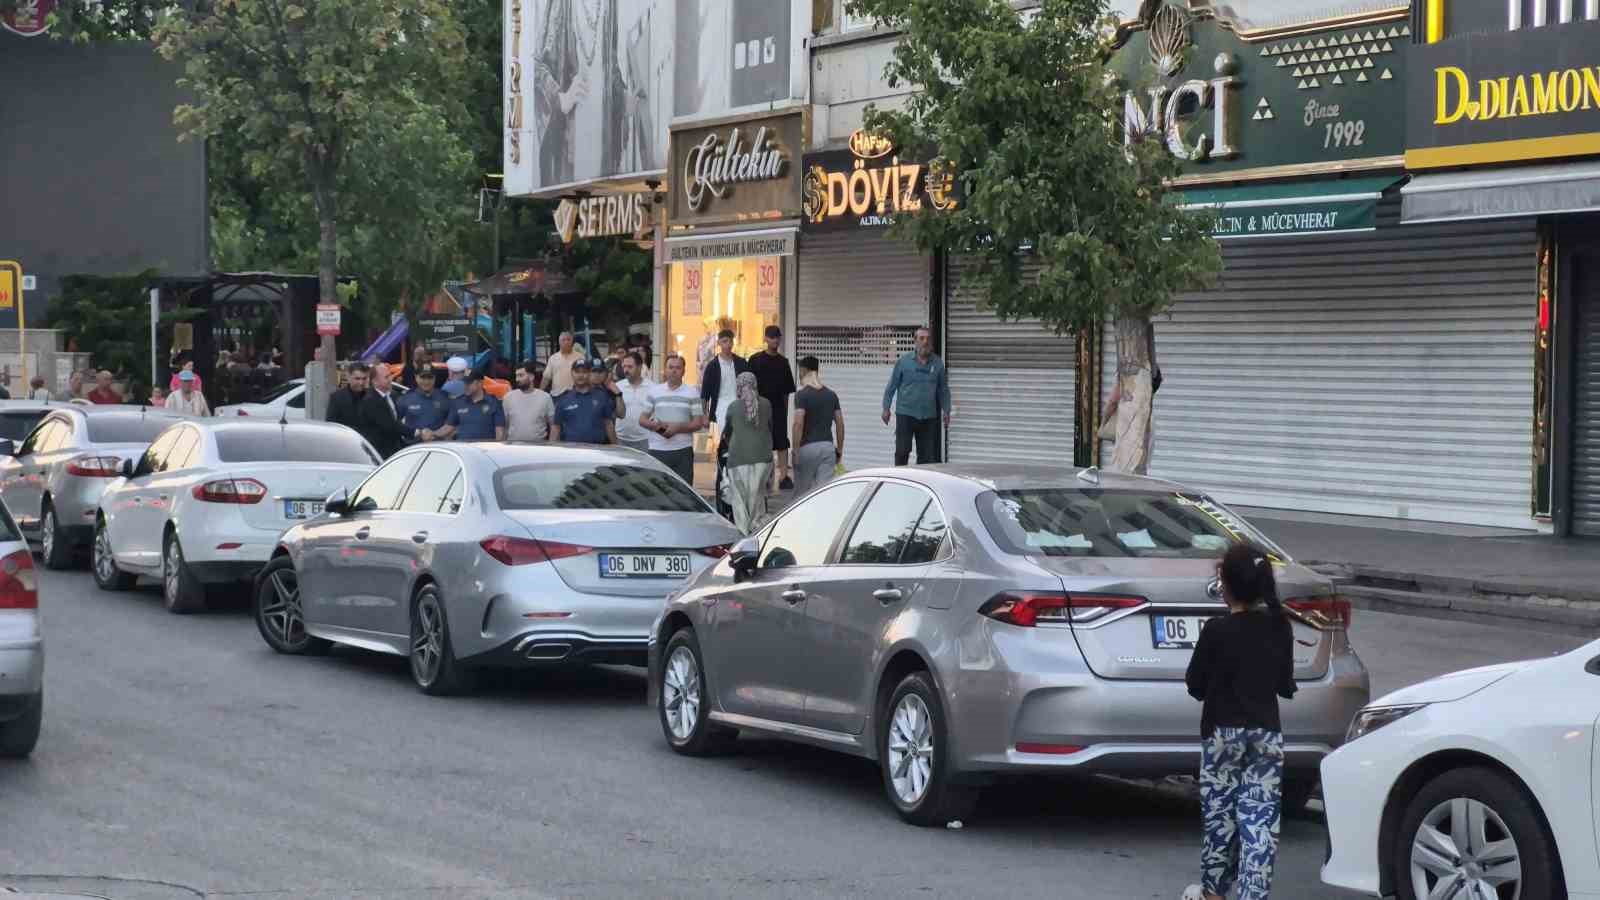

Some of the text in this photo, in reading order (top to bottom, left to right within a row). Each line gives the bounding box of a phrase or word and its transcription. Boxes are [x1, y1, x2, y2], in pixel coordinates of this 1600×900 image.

[1304, 99, 1340, 127] Since
[1324, 119, 1365, 149] 1992
[685, 126, 783, 210] Gültekin
[827, 155, 921, 216] DÖVİZ
[578, 193, 643, 238] SETRMS
[1247, 218, 1257, 231] &
[686, 269, 700, 290] 30
[759, 265, 775, 287] 30
[293, 502, 305, 514] 06
[608, 556, 688, 572] 06 DNV 380
[1166, 619, 1188, 640] 06
